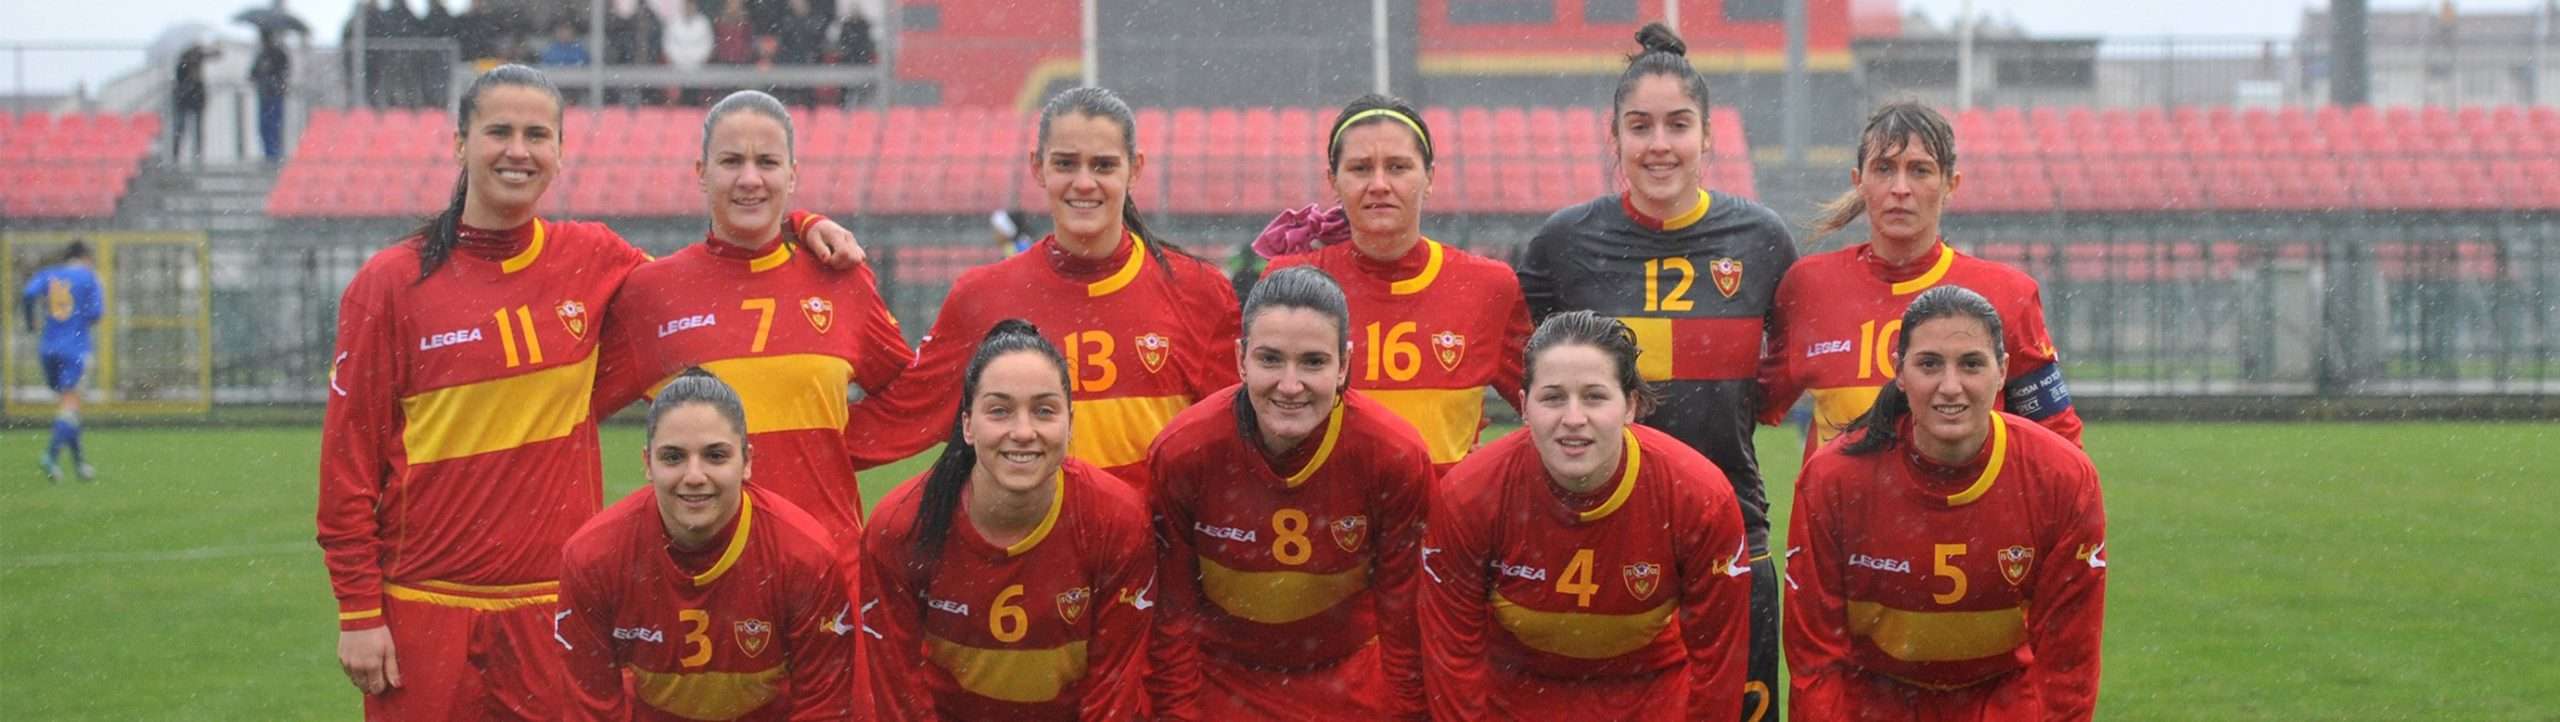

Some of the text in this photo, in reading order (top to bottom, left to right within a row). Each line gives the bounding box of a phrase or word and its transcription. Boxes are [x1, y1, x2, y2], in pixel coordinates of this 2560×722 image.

[1643, 257, 1696, 313] 12
[419, 327, 483, 351] LEGEA
[494, 304, 543, 369] 11
[658, 313, 716, 338] LEGEA
[741, 297, 777, 354] 7
[1365, 321, 1422, 382] 16
[1806, 339, 1852, 358] LEGEA
[1063, 330, 1118, 392] 13
[1193, 521, 1257, 543] LEGEA
[1272, 509, 1312, 566] 8
[1555, 548, 1600, 608] 4
[1847, 553, 1911, 574] LEGEA
[1932, 543, 1968, 605] 5
[612, 627, 664, 643] EGEA
[679, 608, 713, 668] 3
[988, 584, 1028, 643] 6
